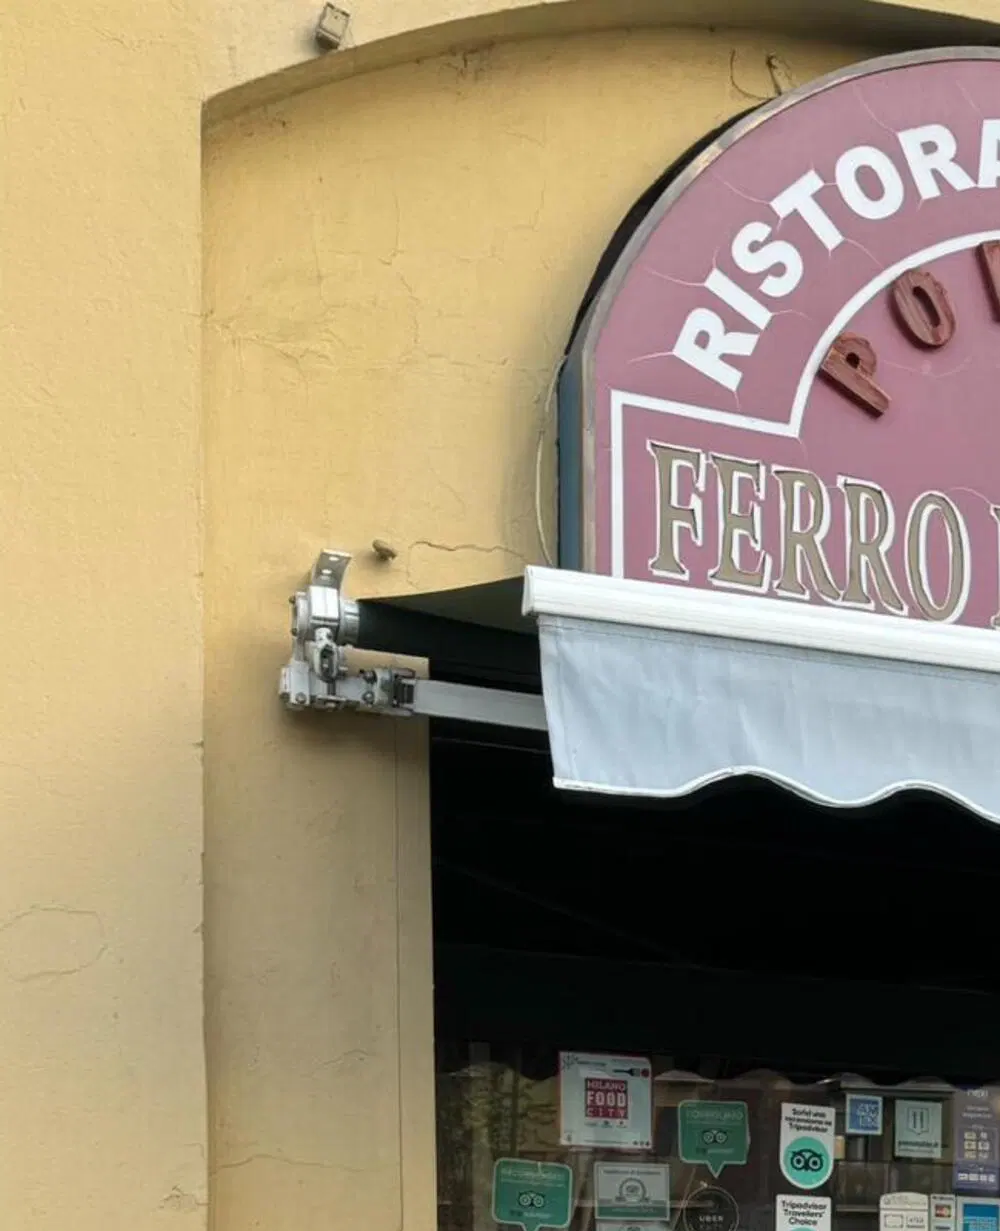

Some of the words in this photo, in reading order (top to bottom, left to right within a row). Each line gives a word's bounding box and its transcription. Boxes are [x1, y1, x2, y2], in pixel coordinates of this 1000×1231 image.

[645, 438, 973, 625] FERRO
[587, 1090, 626, 1107] FOOD
[781, 1200, 827, 1210] Tripadvisor
[788, 1216, 818, 1225] Choice
